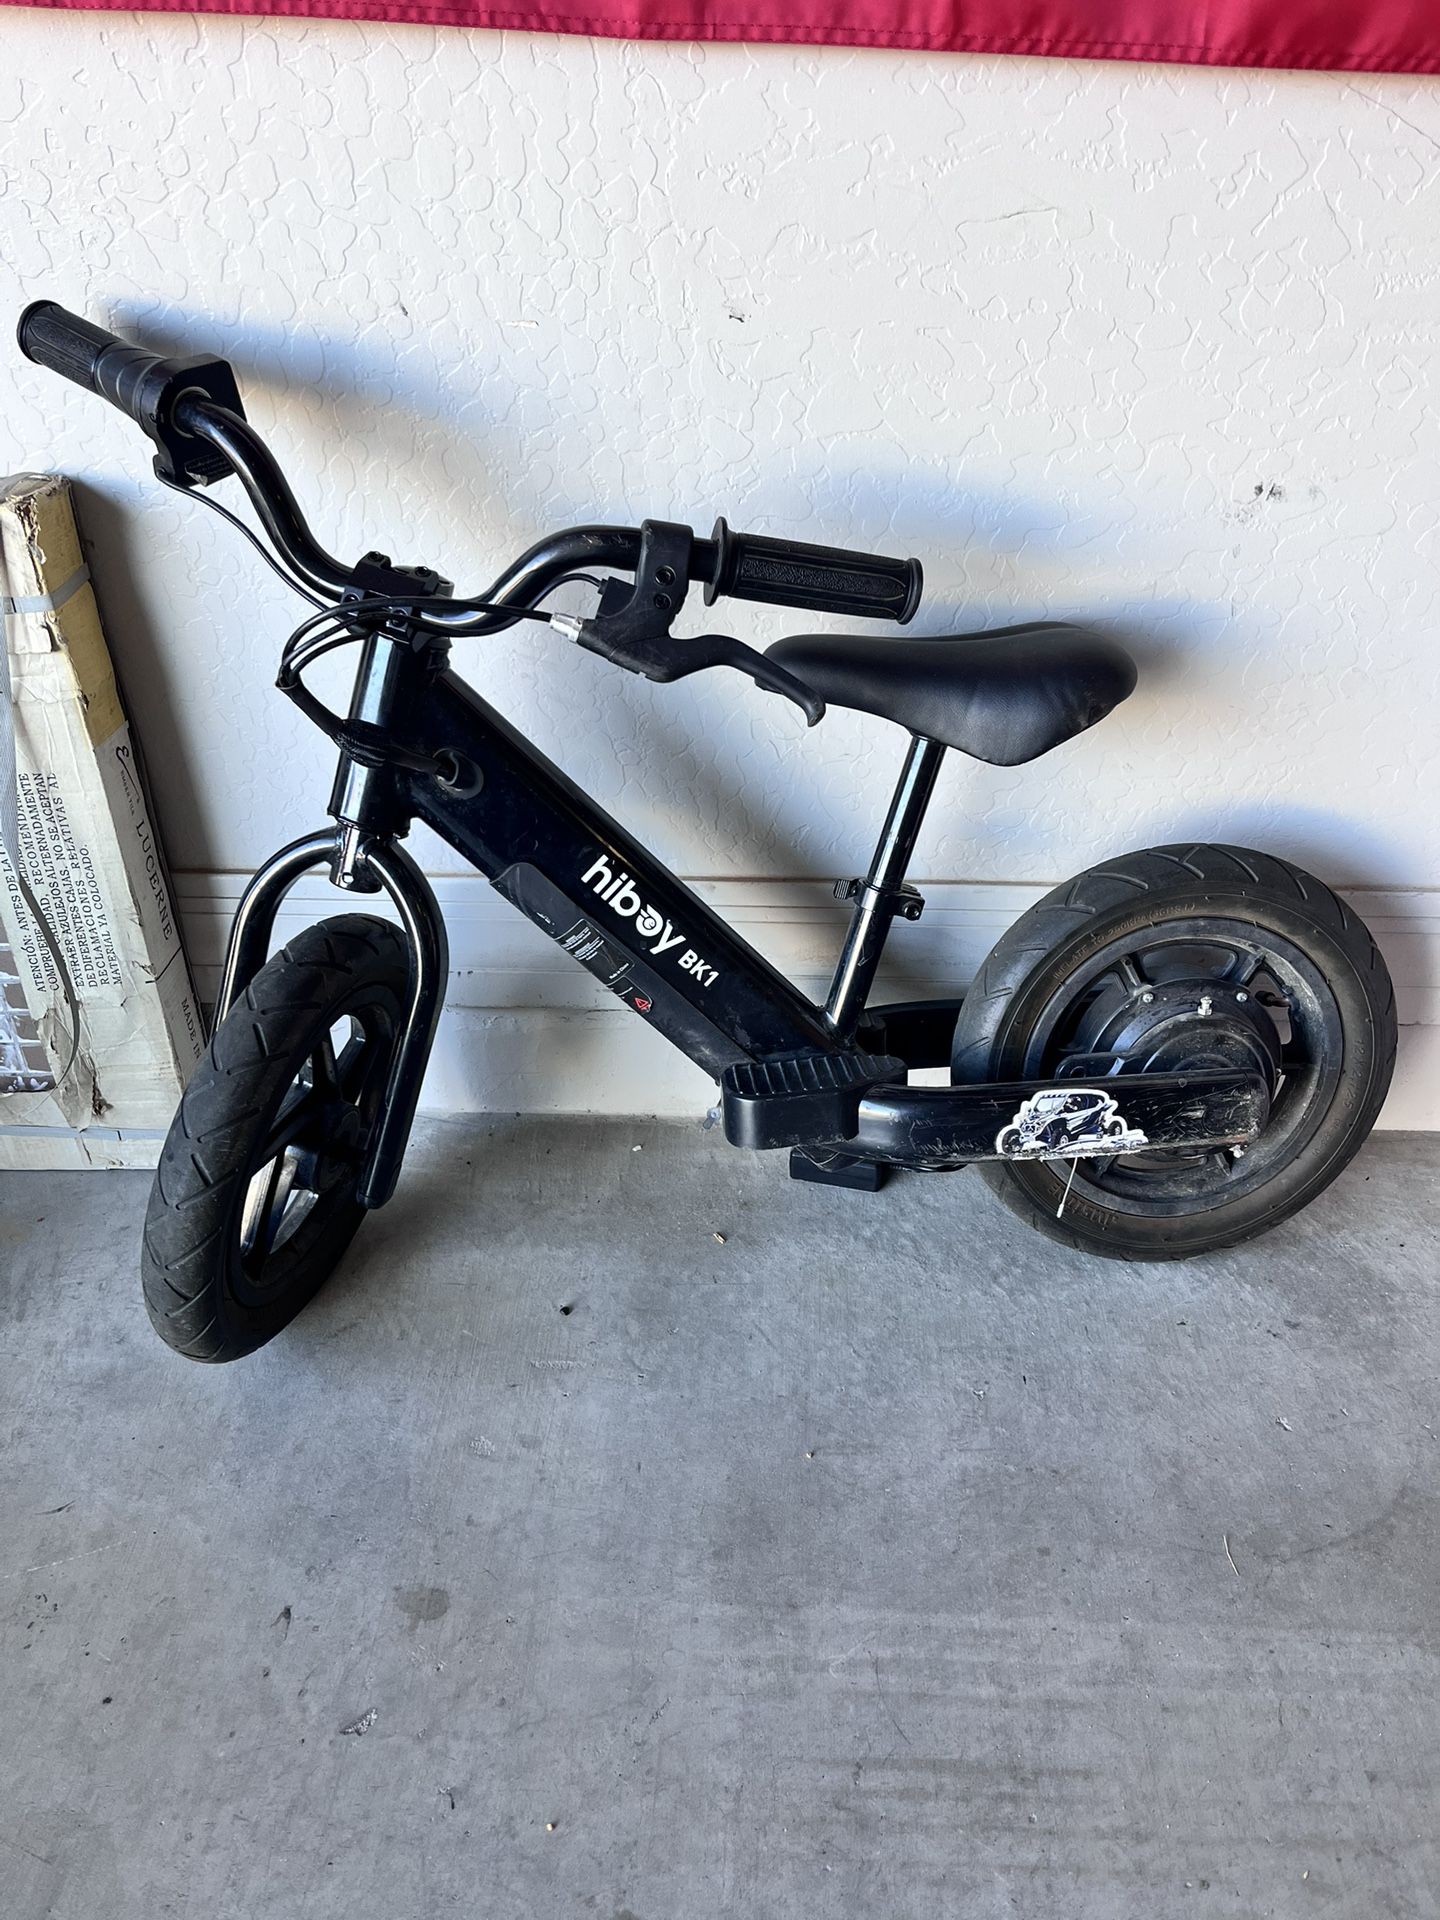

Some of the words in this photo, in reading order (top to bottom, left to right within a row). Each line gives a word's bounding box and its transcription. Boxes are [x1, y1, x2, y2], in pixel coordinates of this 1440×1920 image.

[33, 773, 56, 823] ACEPTAN
[47, 773, 59, 789] AL
[18, 773, 57, 880] ALTERNADAMENTE
[48, 826, 59, 841] SE
[53, 797, 81, 869] RELATIVAS
[1, 858, 13, 872] LA
[53, 845, 66, 861] NO
[79, 844, 103, 910] COLOCADO.
[5, 875, 18, 892] DE
[60, 866, 76, 903] CAJAS.
[136, 820, 172, 940] LUCERNE
[11, 895, 29, 931] ANTES
[49, 881, 72, 934] AZULEJOS
[76, 879, 110, 985] RECLAMACIONES
[97, 914, 108, 928] YA
[581, 854, 687, 955] hiboy
[677, 949, 720, 987] BK1
[21, 934, 46, 992] ATENCIÓN:
[65, 938, 85, 987] EXTRAER
[70, 906, 94, 971] DIFERENTES
[102, 931, 122, 985] MATERIAL
[86, 973, 98, 987] DE
[181, 997, 197, 1041] MADE
[193, 1042, 202, 1060] IN
